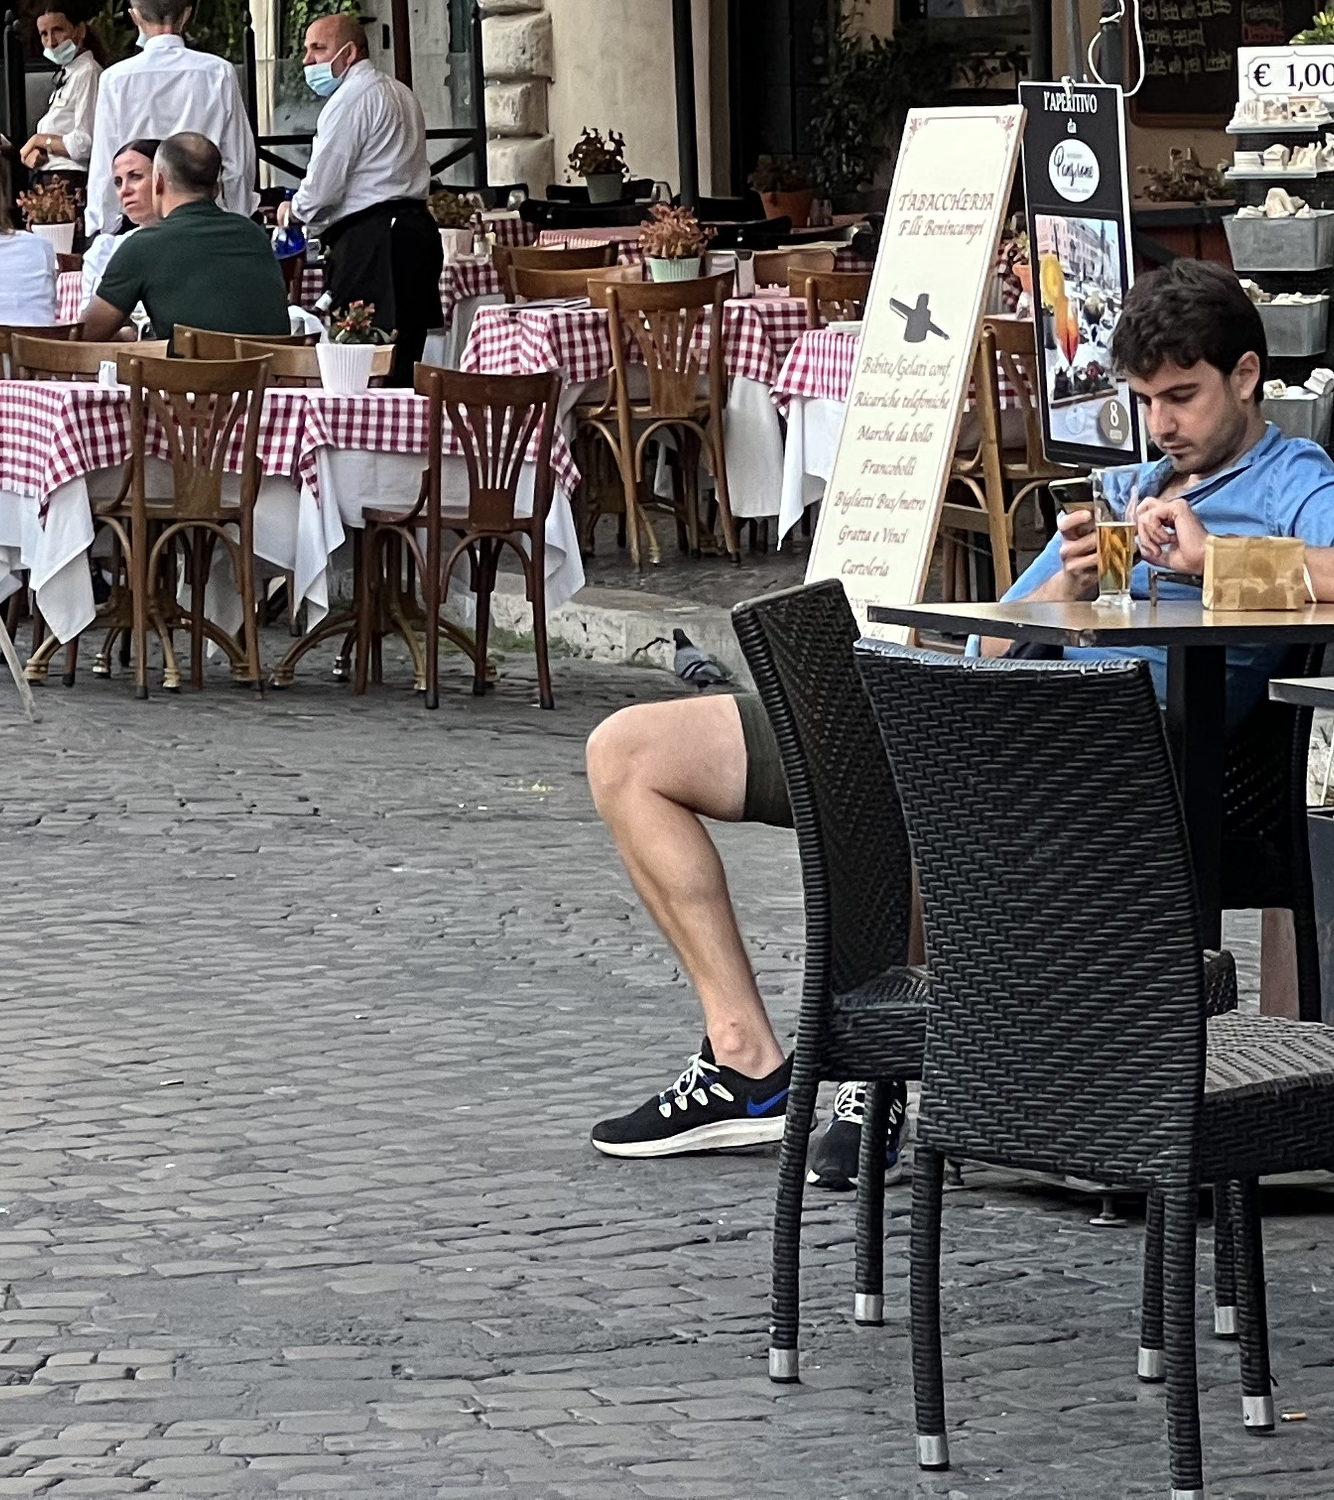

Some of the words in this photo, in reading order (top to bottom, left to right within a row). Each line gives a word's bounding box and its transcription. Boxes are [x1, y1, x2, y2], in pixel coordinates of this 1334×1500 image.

[1253, 63, 1272, 87] €
[898, 188, 995, 212] TABACCHERIA
[1109, 401, 1120, 427] 8
[857, 422, 894, 442] Marche
[895, 422, 910, 442] da
[910, 422, 934, 442] bollo
[861, 456, 918, 476] Francobolli
[837, 525, 872, 545] Gratta
[882, 527, 909, 544] Vinci
